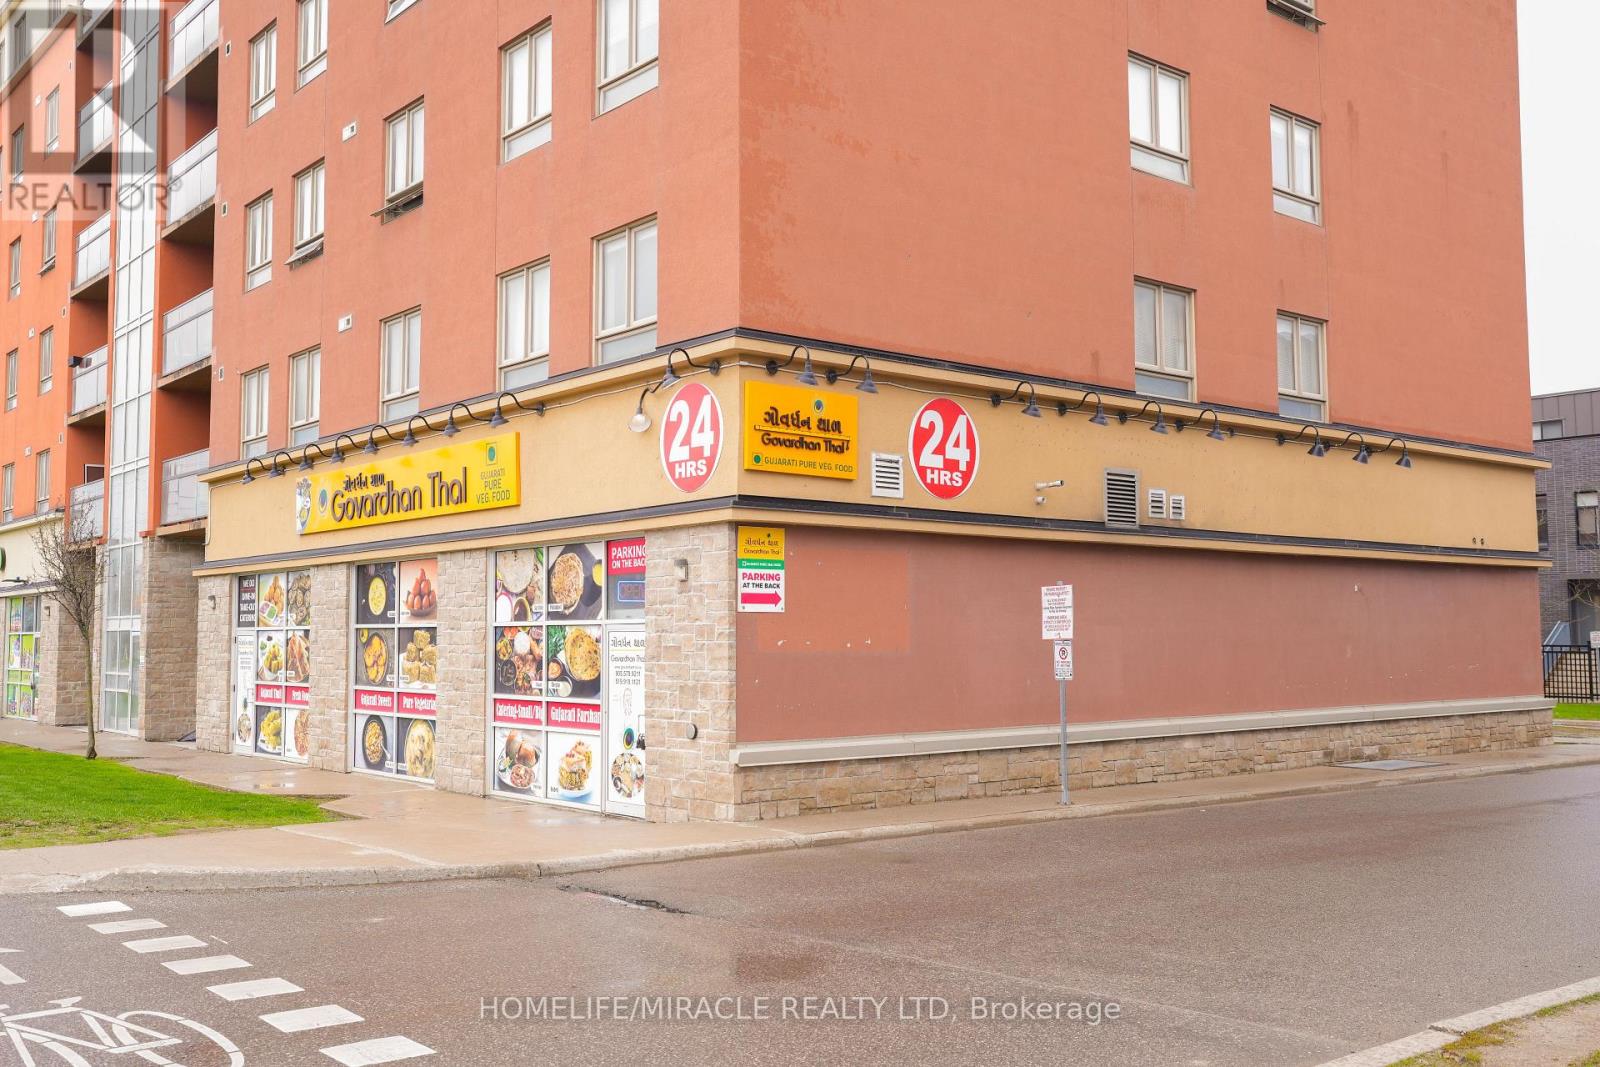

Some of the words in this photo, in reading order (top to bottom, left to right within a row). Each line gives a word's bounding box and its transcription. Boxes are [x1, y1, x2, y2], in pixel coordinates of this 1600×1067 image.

[669, 394, 714, 463] 24
[761, 432, 821, 451] Govardhan
[823, 438, 846, 454] Thal
[919, 409, 970, 471] 24
[675, 458, 708, 480] HRS
[764, 456, 798, 467] GUJARATI
[798, 459, 816, 470] PURE
[835, 463, 853, 473] FOOD
[480, 468, 505, 480] GUJARATI
[926, 469, 963, 487] HRS
[484, 478, 502, 491] PURE
[331, 480, 423, 523] Govardhan
[427, 466, 467, 508] Thal
[492, 490, 511, 503] FOOD
[612, 560, 621, 569] ON
[622, 559, 633, 568] THE
[742, 572, 781, 582] PARKING
[551, 707, 575, 723] Gujarati
